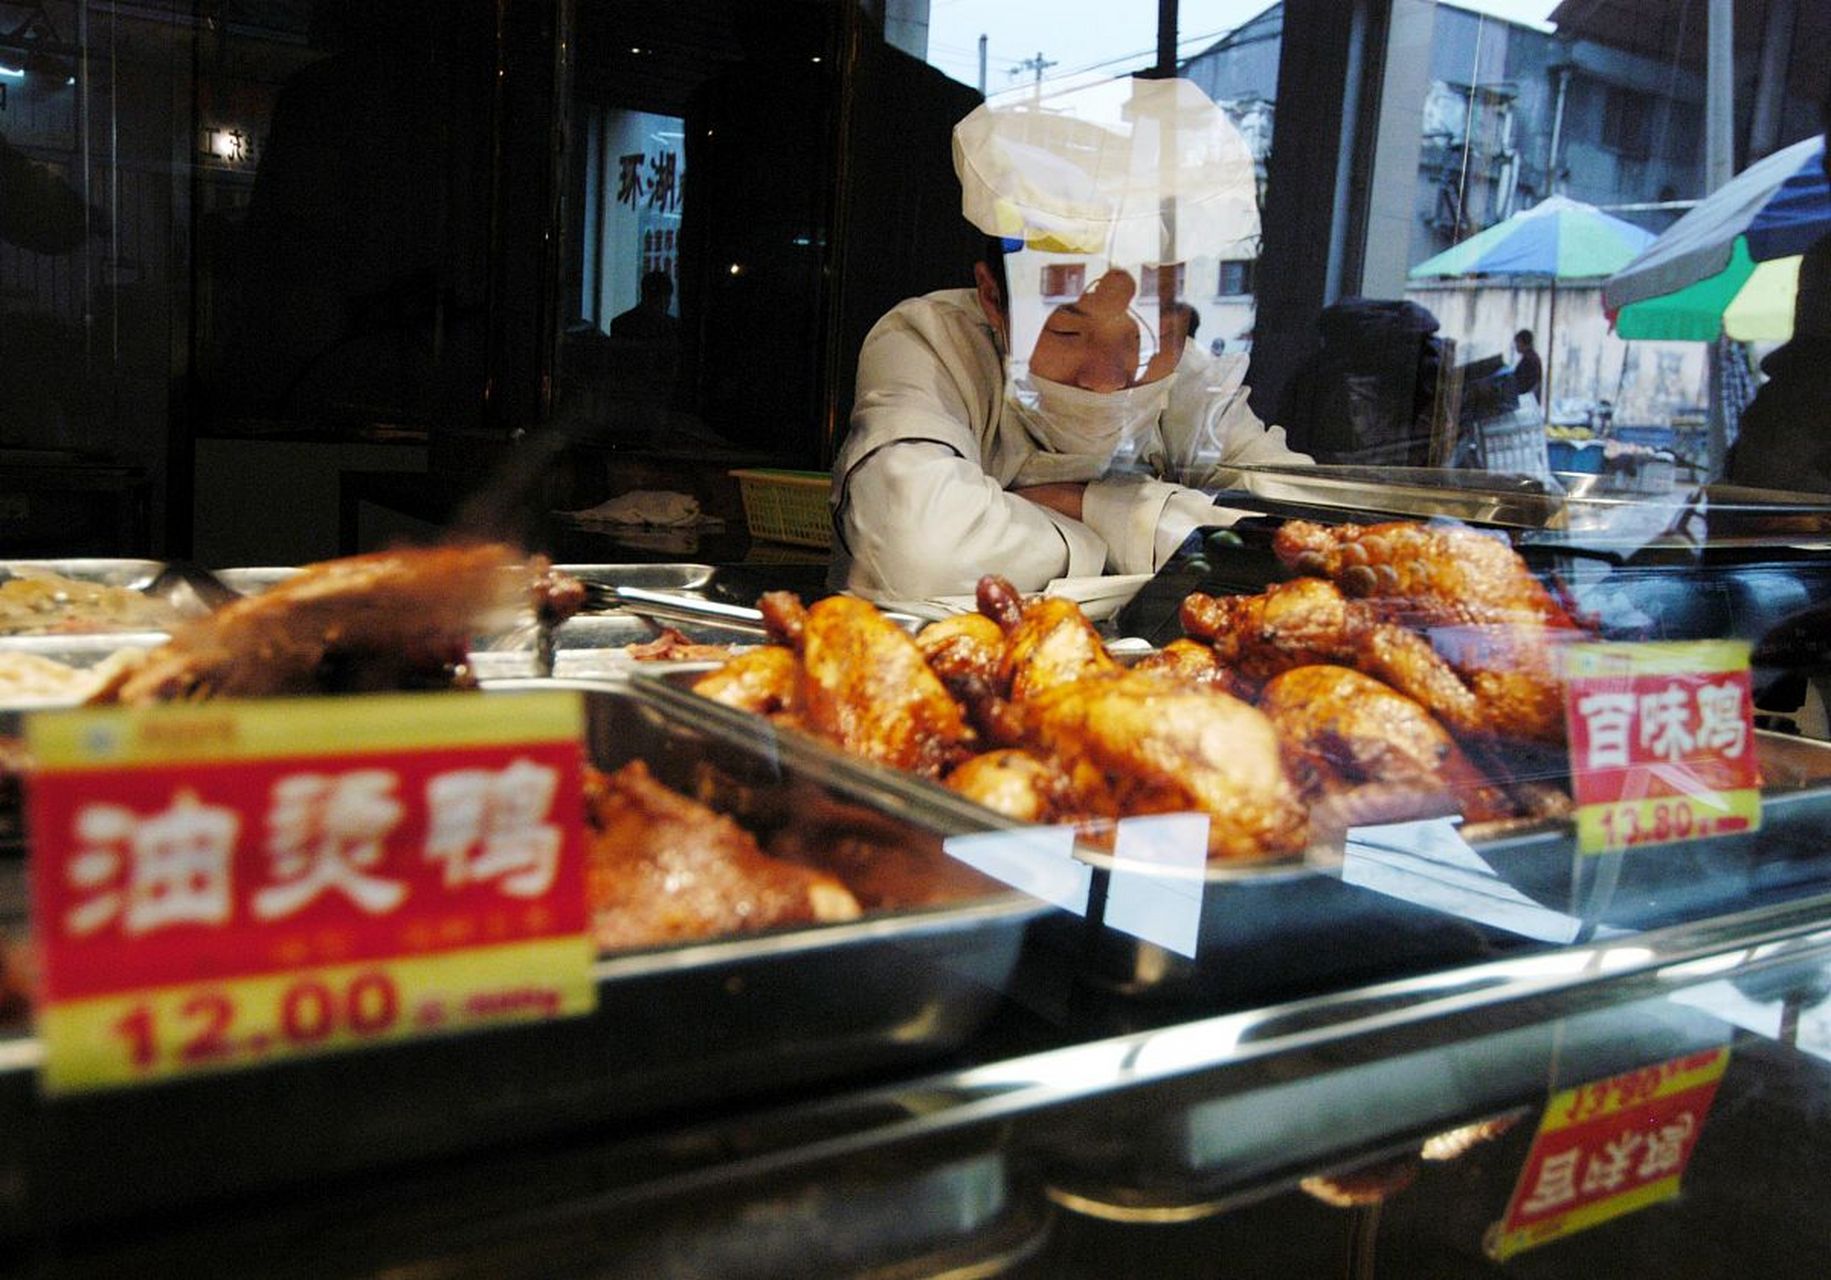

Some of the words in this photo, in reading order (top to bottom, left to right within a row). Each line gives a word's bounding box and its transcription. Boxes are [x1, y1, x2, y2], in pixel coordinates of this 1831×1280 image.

[1577, 682, 1746, 769] 百味鸡
[66, 758, 562, 936] 油烫鸭
[112, 970, 400, 1072] 12.00
